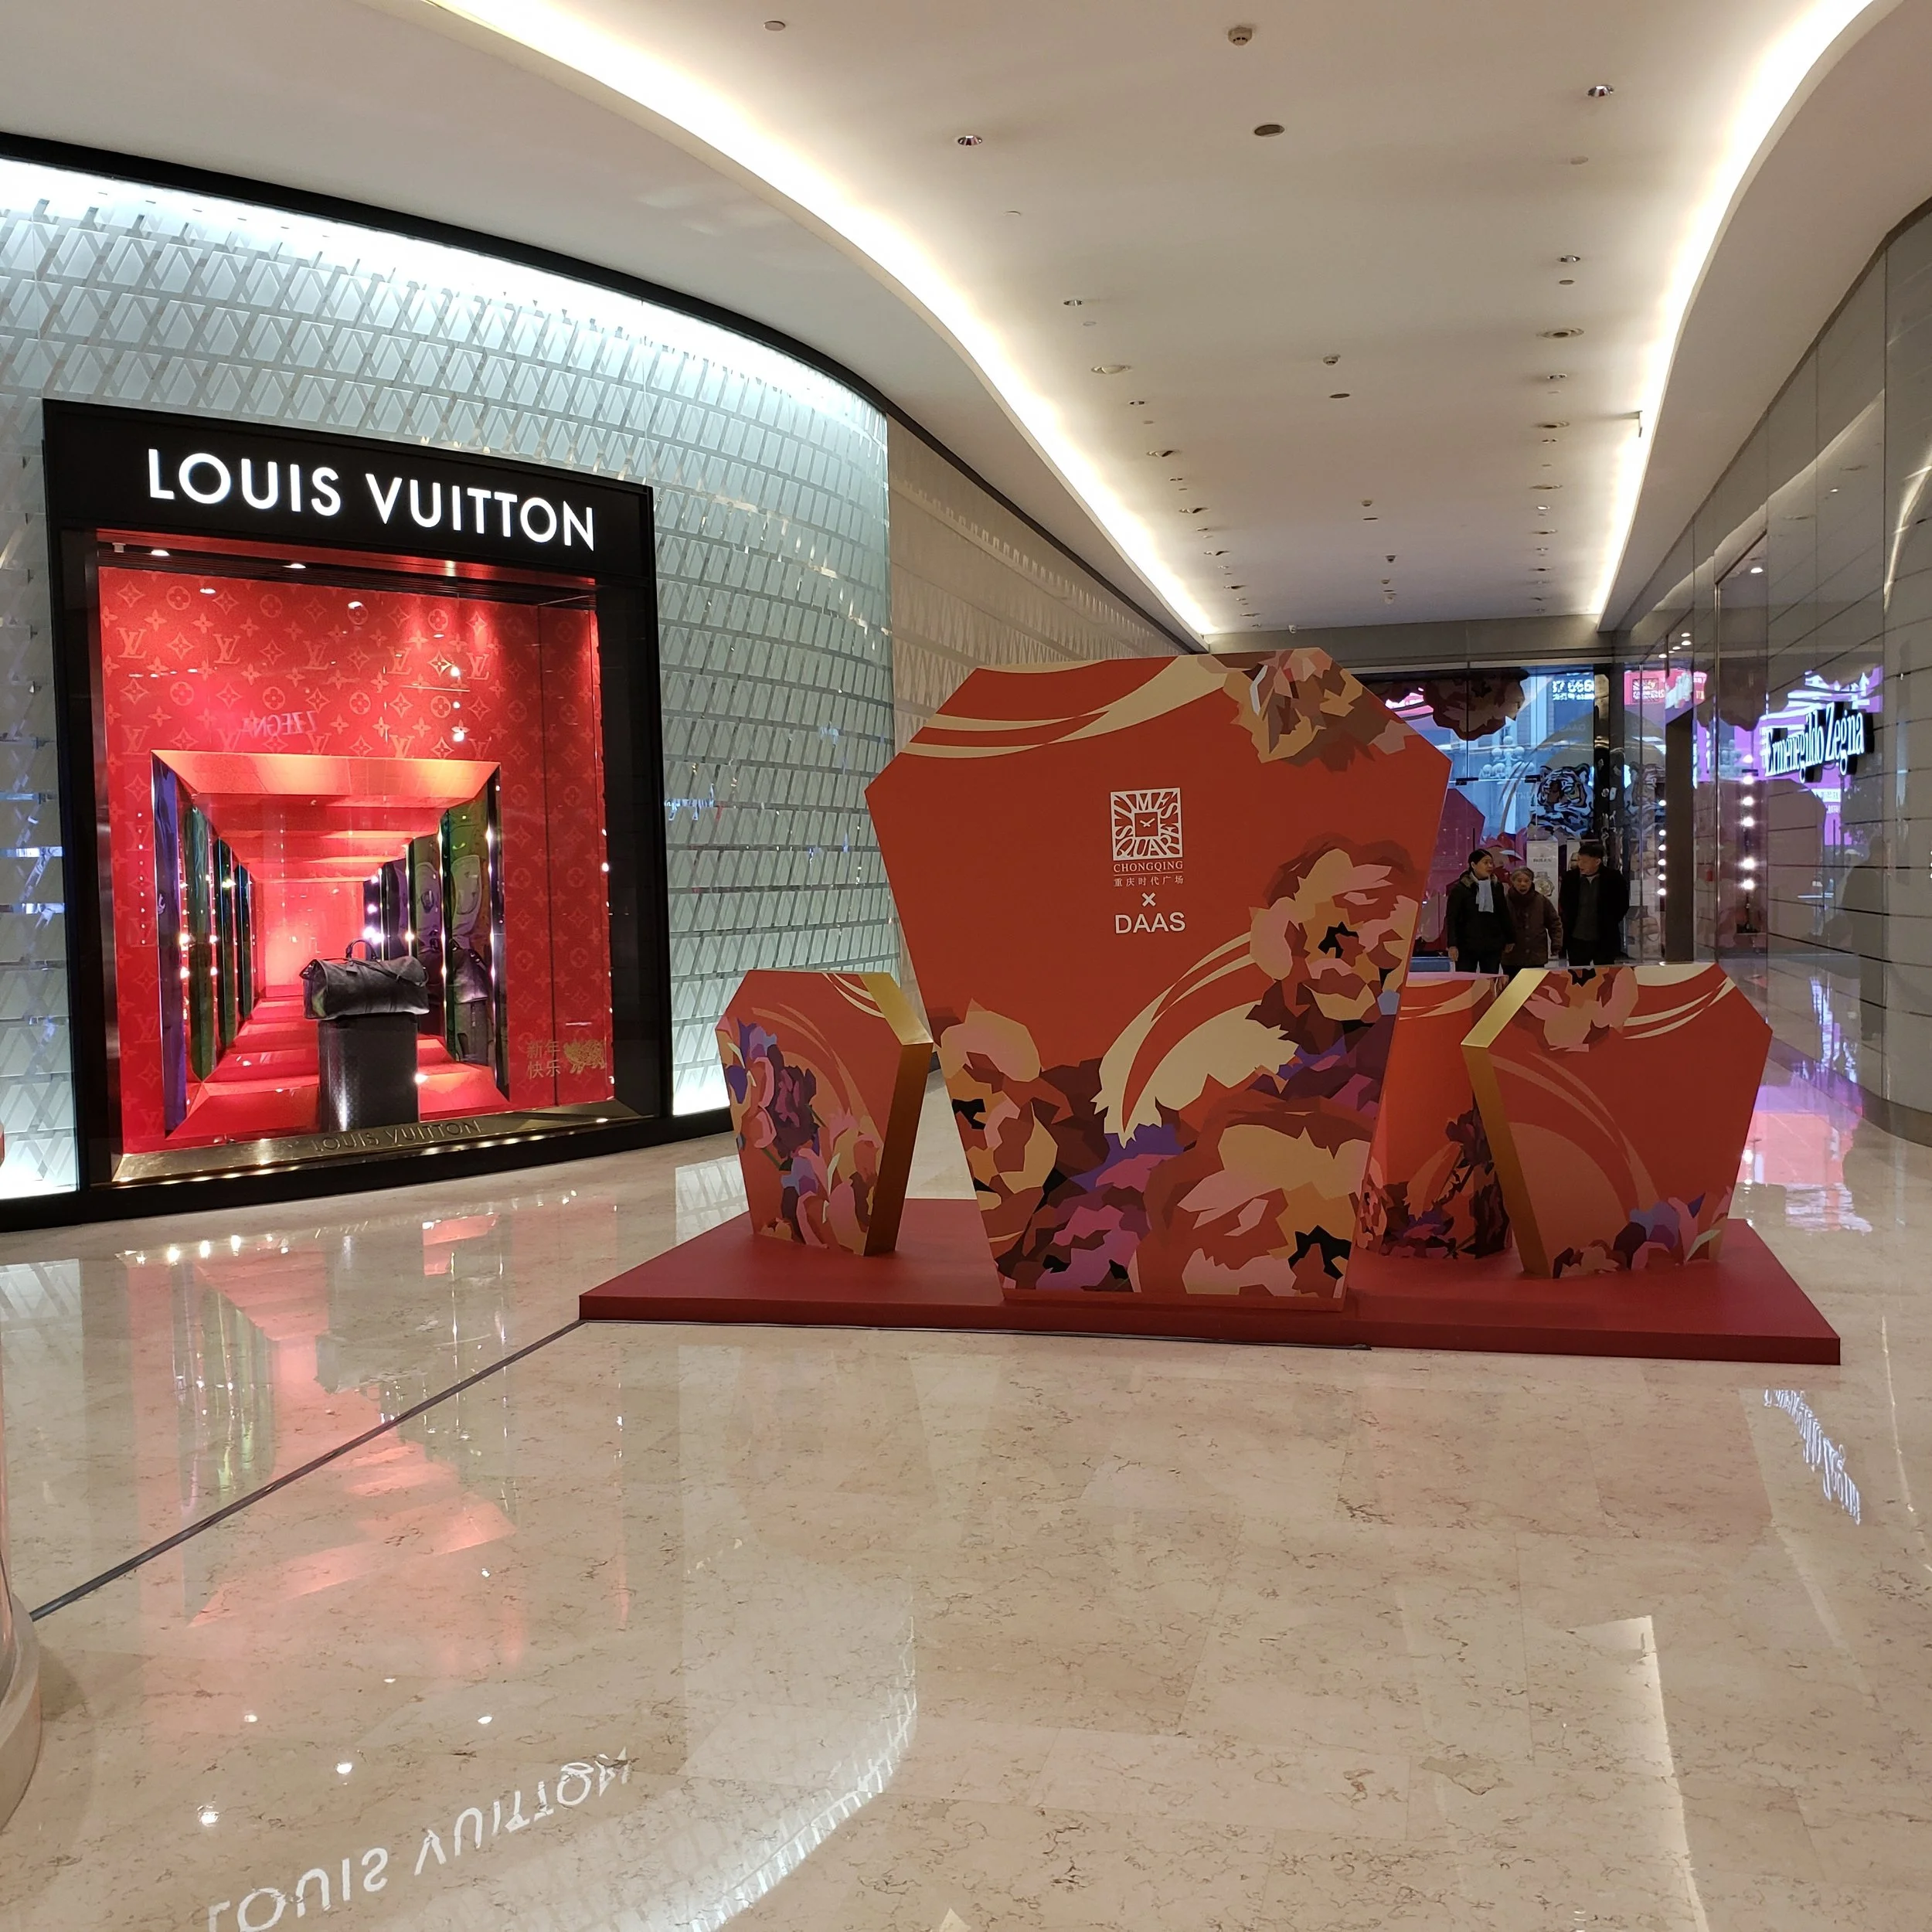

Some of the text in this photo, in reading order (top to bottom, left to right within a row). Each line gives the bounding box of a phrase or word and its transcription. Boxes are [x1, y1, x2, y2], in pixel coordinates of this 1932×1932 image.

[148, 448, 594, 552] LOUIS VUITTON
[1763, 702, 1864, 784] Ermenegildo Zegna
[1113, 860, 1183, 872] CHONGQING
[1114, 875, 1184, 887] 重庆时代广场
[1115, 911, 1185, 934] DAAS
[526, 1039, 560, 1059] 新年
[527, 1059, 561, 1080] 快乐
[311, 1119, 481, 1152] LOUIS VUITTON
